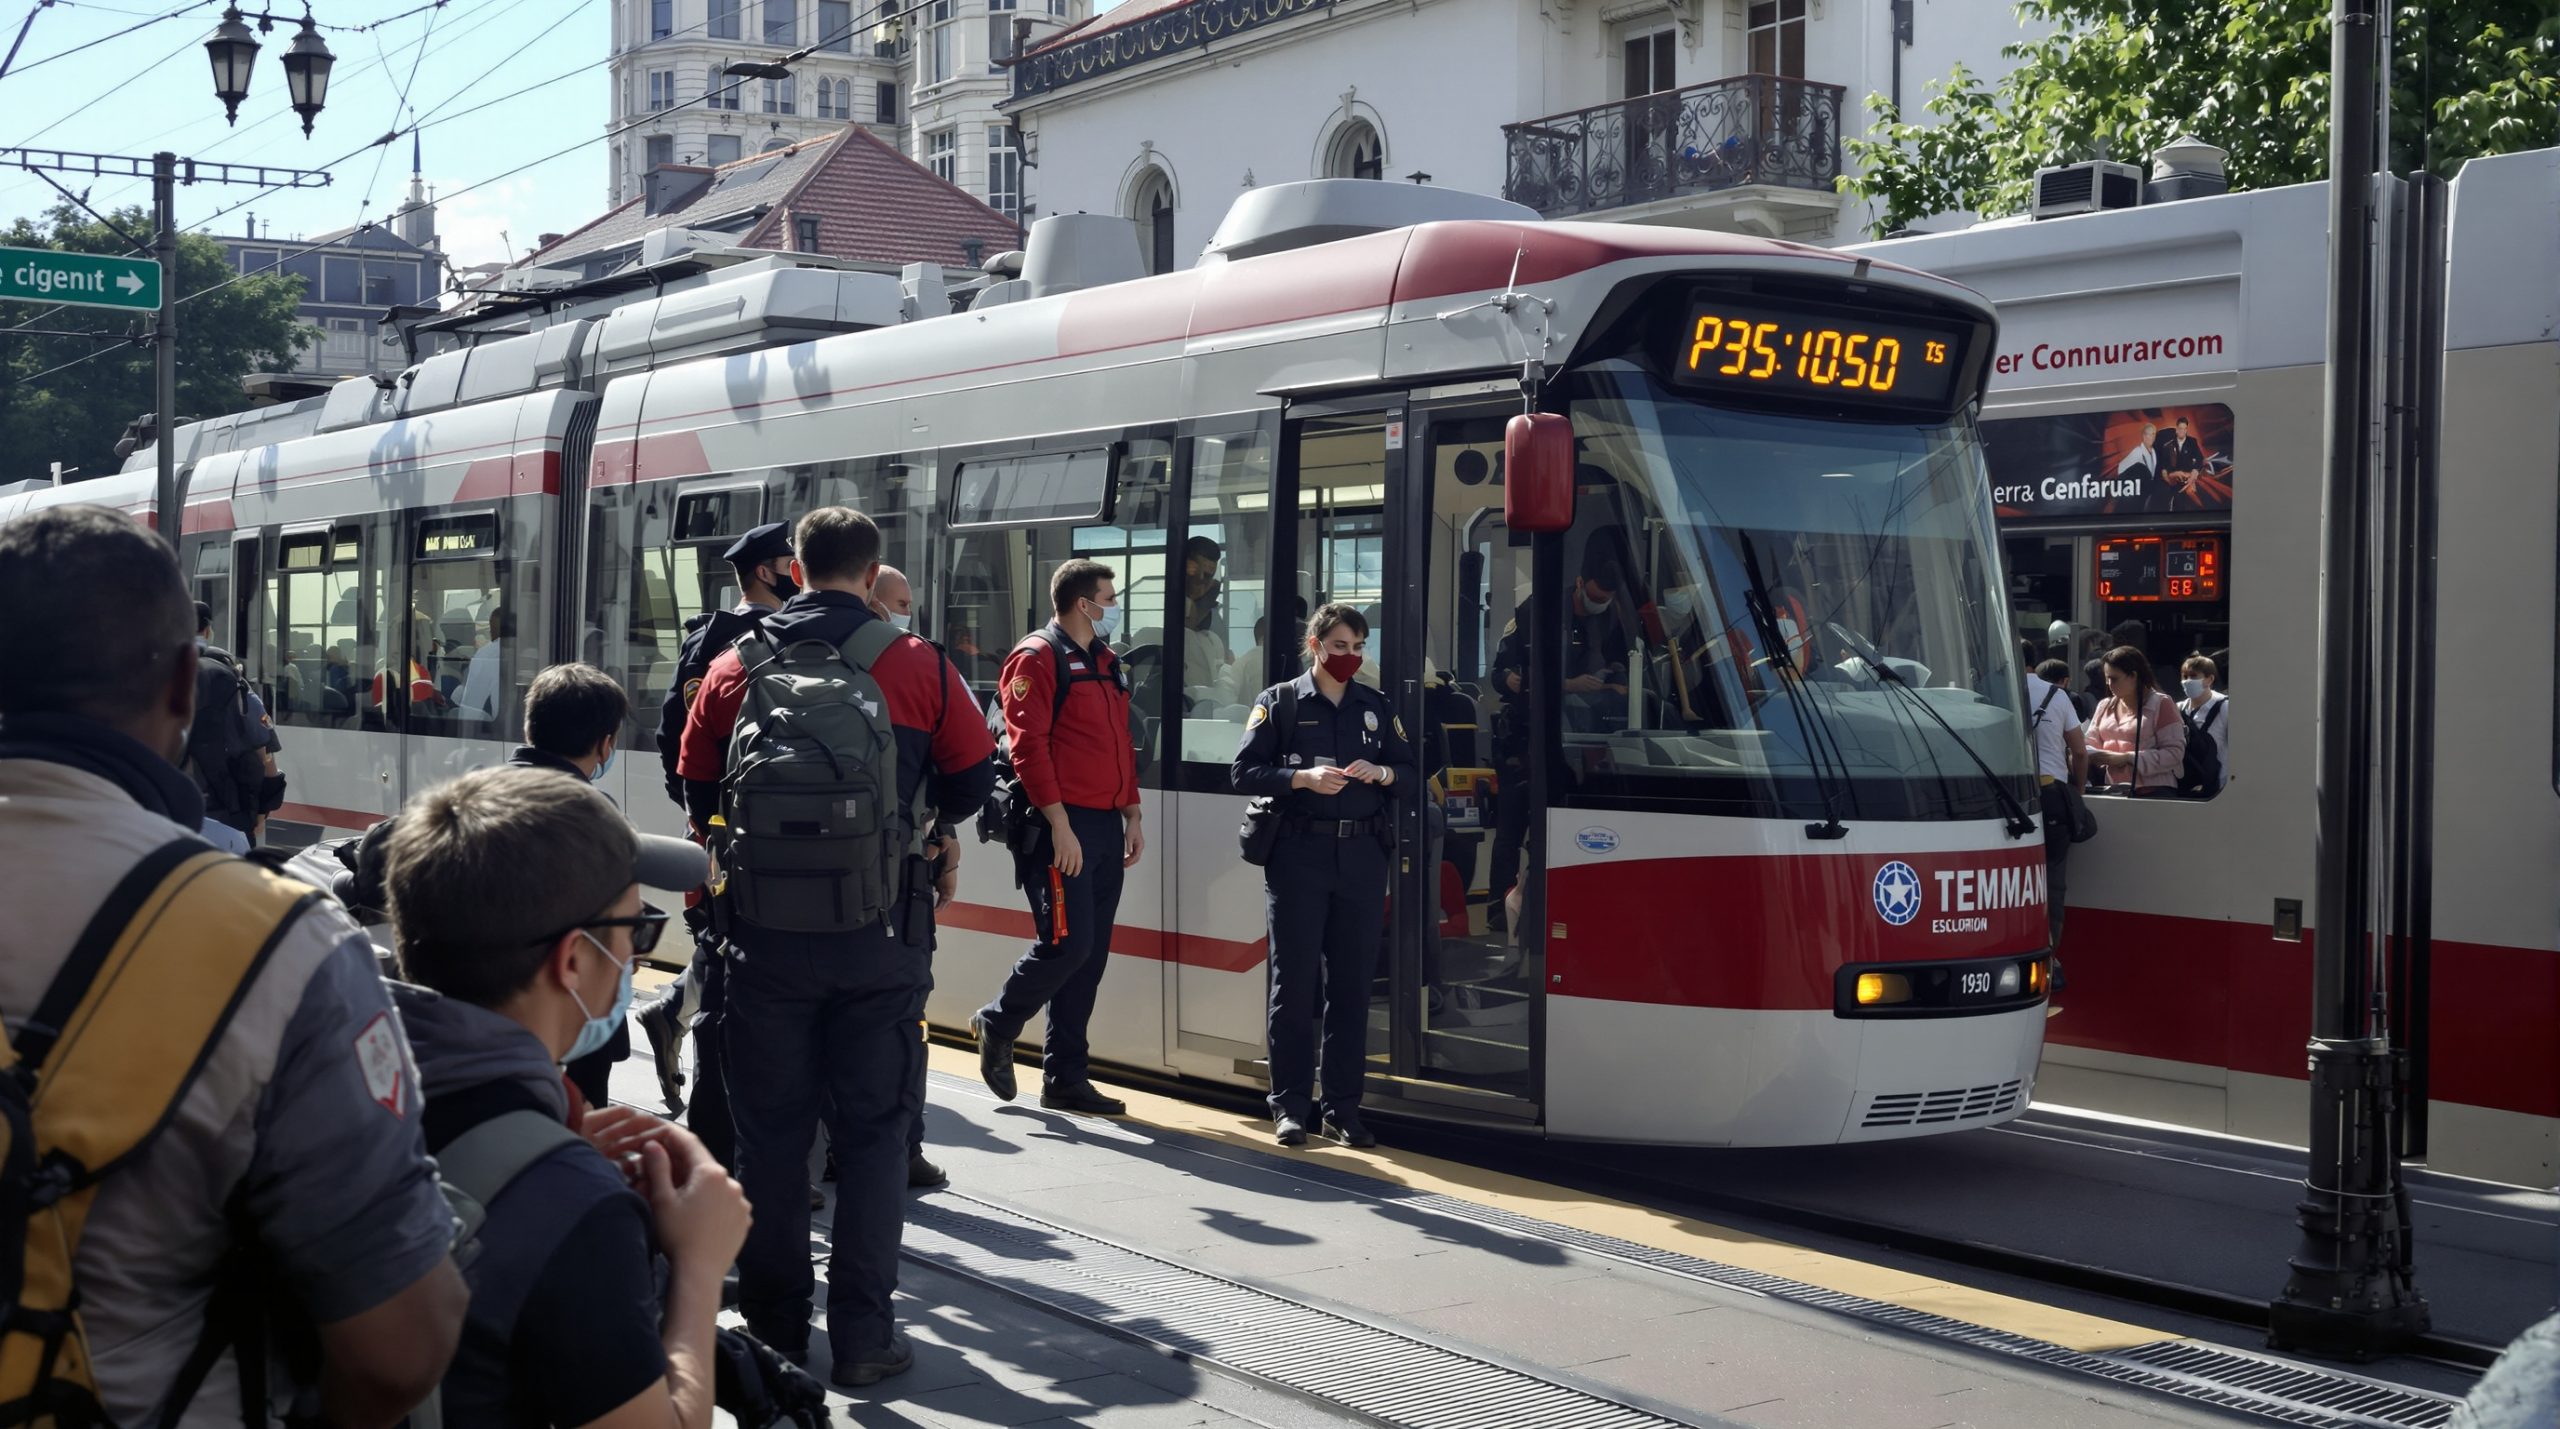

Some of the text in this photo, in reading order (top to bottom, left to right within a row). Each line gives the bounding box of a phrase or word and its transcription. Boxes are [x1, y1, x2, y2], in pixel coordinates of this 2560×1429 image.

[2031, 334, 2223, 371] Connurarcom
[1934, 863, 2048, 912] TEMMAN
[1961, 972, 1991, 994] 1930
